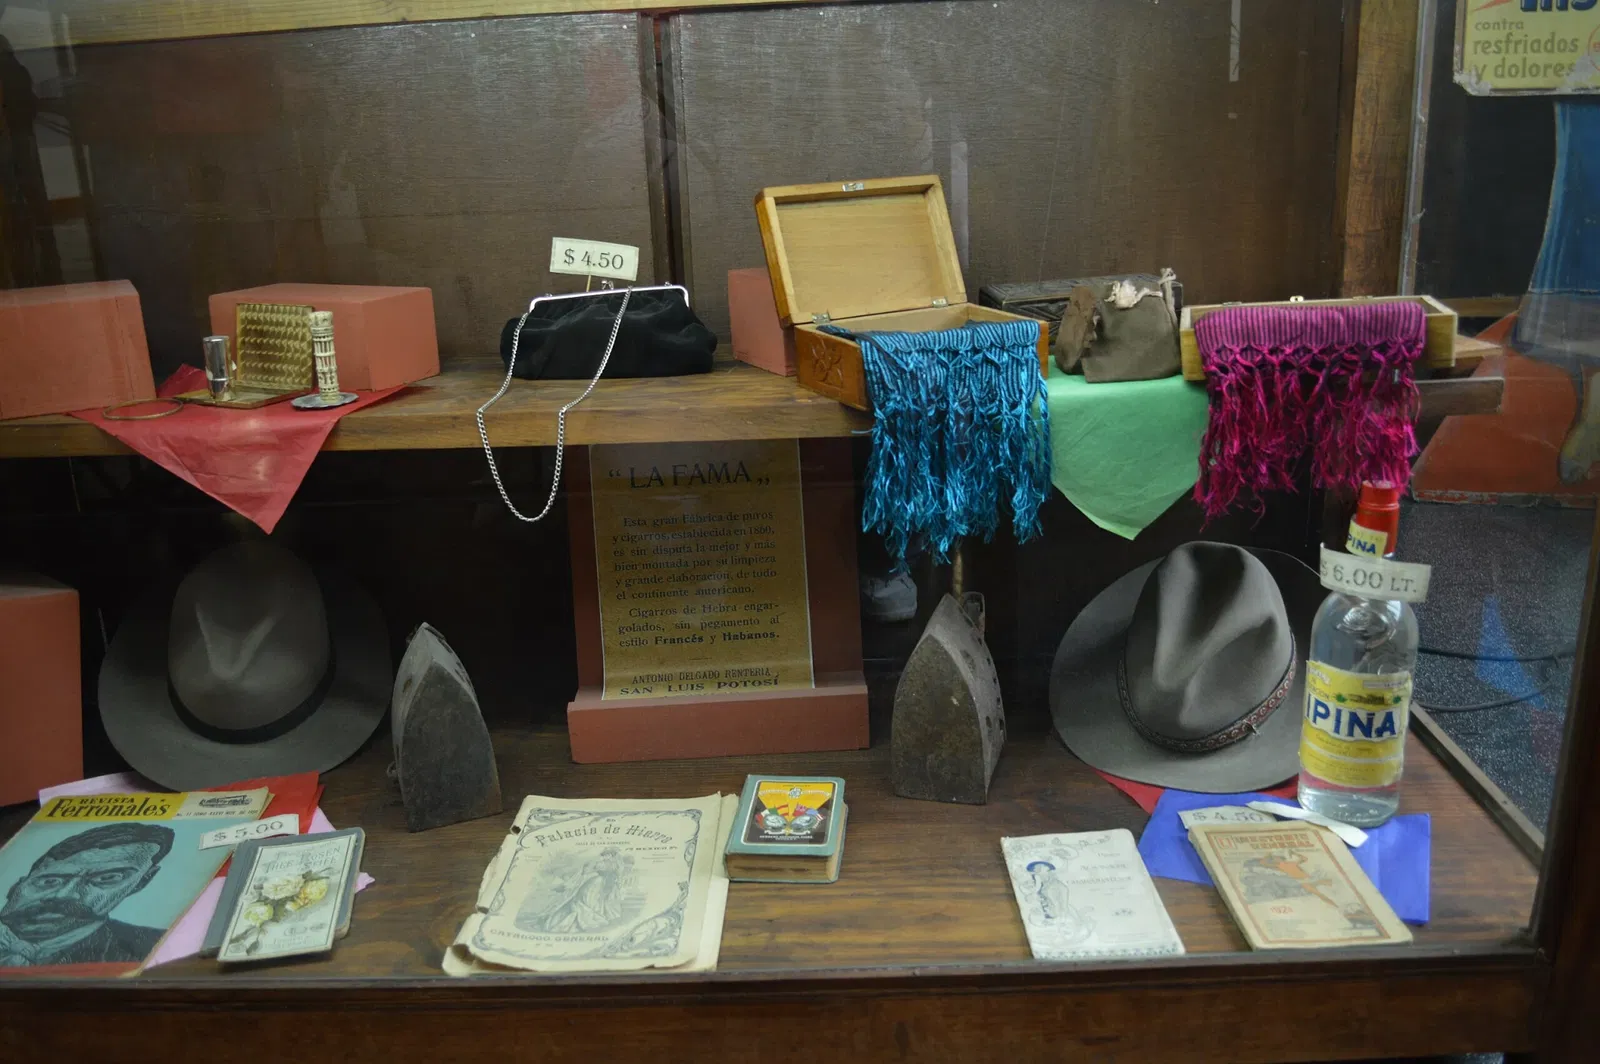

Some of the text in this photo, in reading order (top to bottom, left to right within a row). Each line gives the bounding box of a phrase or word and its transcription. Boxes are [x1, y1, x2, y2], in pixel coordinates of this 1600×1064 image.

[1474, 18, 1524, 31] contra
[1473, 32, 1580, 55] resfriados
[563, 247, 624, 270] $ 4.50
[629, 465, 665, 489] LA
[672, 460, 752, 487] FAMA
[623, 516, 647, 528] Esta
[652, 516, 679, 529] gran
[726, 512, 740, 522] de
[742, 511, 773, 524] puros
[612, 534, 619, 545] y
[621, 531, 670, 545] cigarros,
[671, 526, 732, 540] establecida
[733, 528, 747, 537] en
[613, 548, 625, 557] es
[630, 546, 647, 556] sin
[652, 544, 693, 557] disputa
[696, 543, 706, 553] la
[709, 541, 740, 555] mejor
[744, 542, 751, 552] y
[614, 553, 777, 572] bien montada por su limpieza
[615, 577, 622, 588] y
[624, 573, 664, 588] grande
[736, 569, 750, 580] de
[752, 567, 777, 579] todo
[1332, 563, 1383, 590] 6.00
[1390, 576, 1417, 594] LT.
[616, 590, 626, 600] el
[631, 586, 689, 600] continente
[628, 605, 678, 620] Cigarros
[682, 604, 697, 615] de
[702, 602, 737, 614] Hebra
[618, 614, 780, 635] golados, sin pegamento al
[619, 629, 780, 648] estilo Francés y Habanos.
[632, 671, 674, 685] ANTONIO
[679, 669, 720, 682] DELGADO
[620, 686, 653, 696] SAN
[667, 682, 705, 693] LUIS
[46, 796, 171, 818] Ferronales
[79, 797, 135, 805] REVISTA
[234, 820, 283, 839] 5.00
[534, 824, 673, 847] Palacio de Hierro
